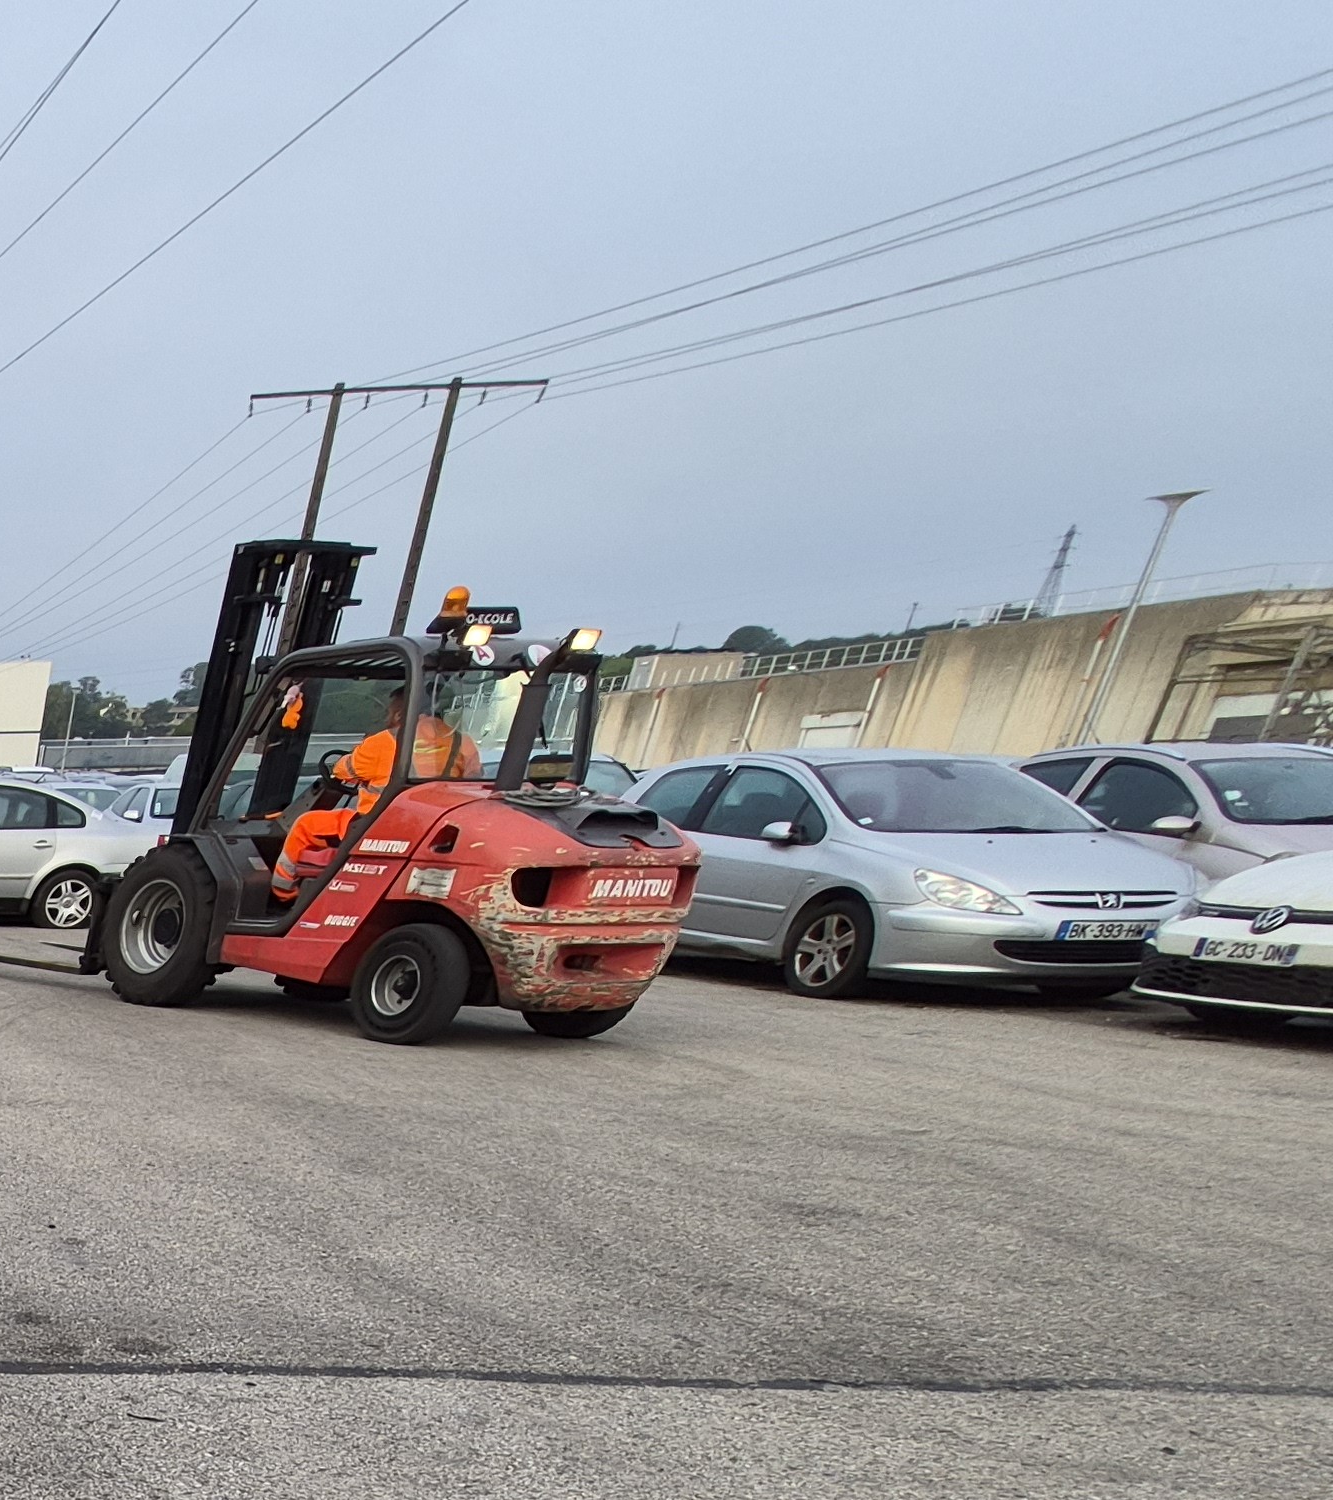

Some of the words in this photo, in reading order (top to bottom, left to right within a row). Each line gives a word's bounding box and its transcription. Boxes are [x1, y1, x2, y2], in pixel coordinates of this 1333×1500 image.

[465, 612, 515, 625] O-ECOLE
[358, 838, 411, 854] MANITOU
[592, 878, 673, 898] MANITOU
[1204, 940, 1286, 962] GC-233-DN
